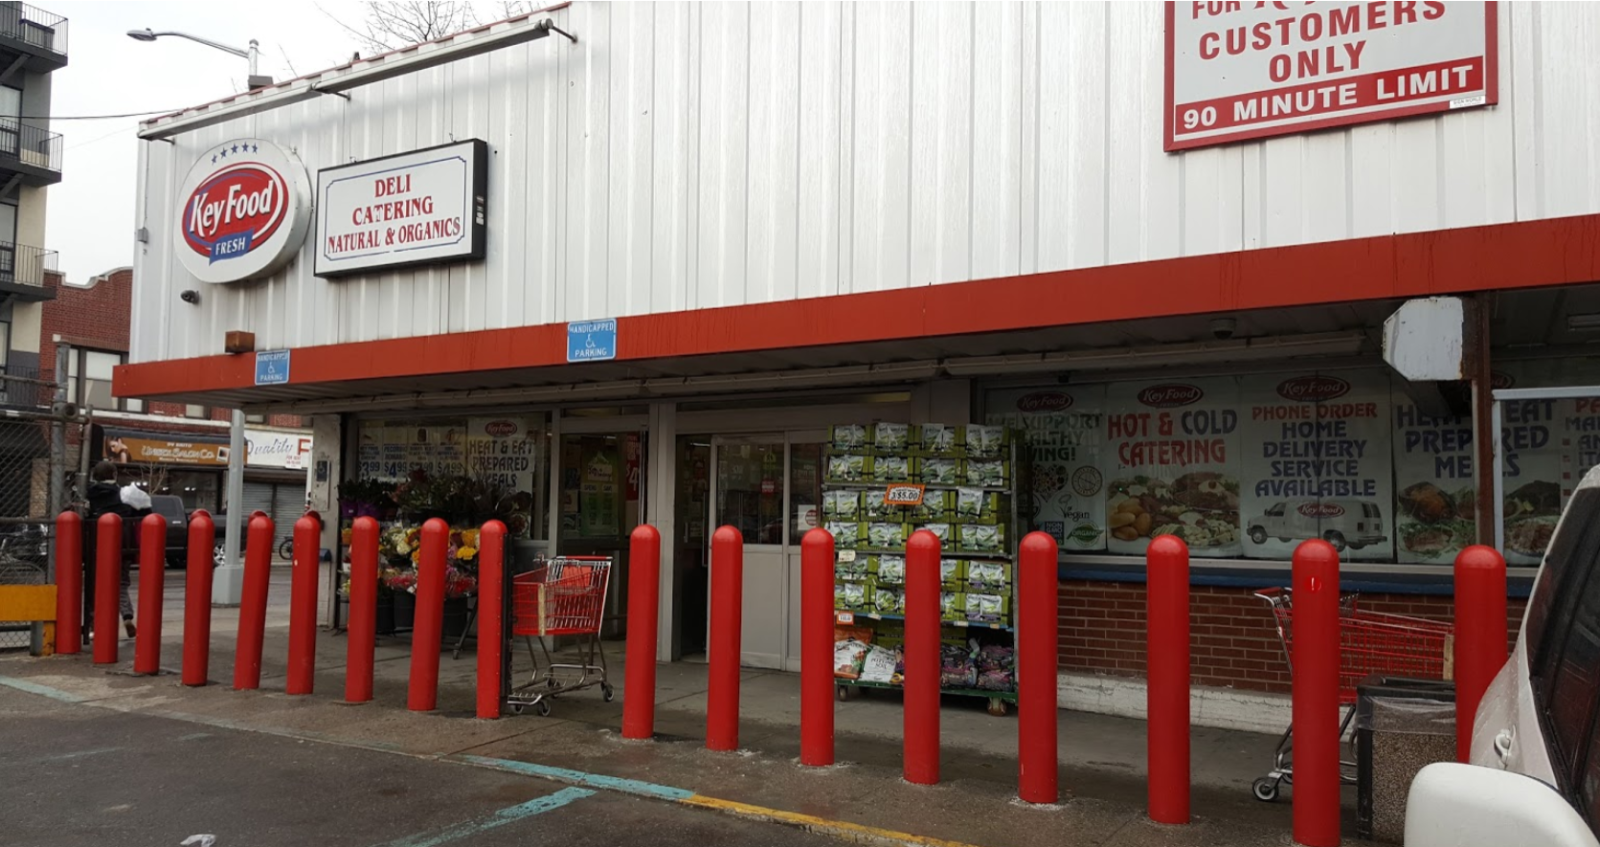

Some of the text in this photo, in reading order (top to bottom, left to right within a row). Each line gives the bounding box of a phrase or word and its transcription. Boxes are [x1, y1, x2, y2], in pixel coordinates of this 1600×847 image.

[1192, 0, 1241, 19] FOR
[1199, 0, 1446, 60] CUSTOMERS
[1269, 40, 1366, 83] ONLY
[1183, 65, 1473, 130] 90 MINUTE LIMIT
[374, 174, 411, 198] DELI
[352, 196, 434, 226] CATERING
[328, 217, 461, 254] NATURAL & ORGANICS
[215, 237, 246, 256] FRESH
[569, 322, 614, 334] HANDICAPPED
[574, 348, 607, 358] PARKING
[260, 373, 283, 382] PARKING
[1252, 402, 1378, 421] PHONE ORDER
[1505, 399, 1558, 424] EAT
[1108, 409, 1237, 441] HOT & COLD
[1282, 420, 1347, 440] HOME
[469, 440, 497, 455] HEAT
[1405, 425, 1549, 454] PREPRED
[1118, 438, 1226, 467] CATERING
[1263, 440, 1367, 459] DELIVERY
[473, 457, 528, 472] PREPARED
[1271, 460, 1358, 478] SERVICE
[1255, 479, 1376, 498] AVAILABLE
